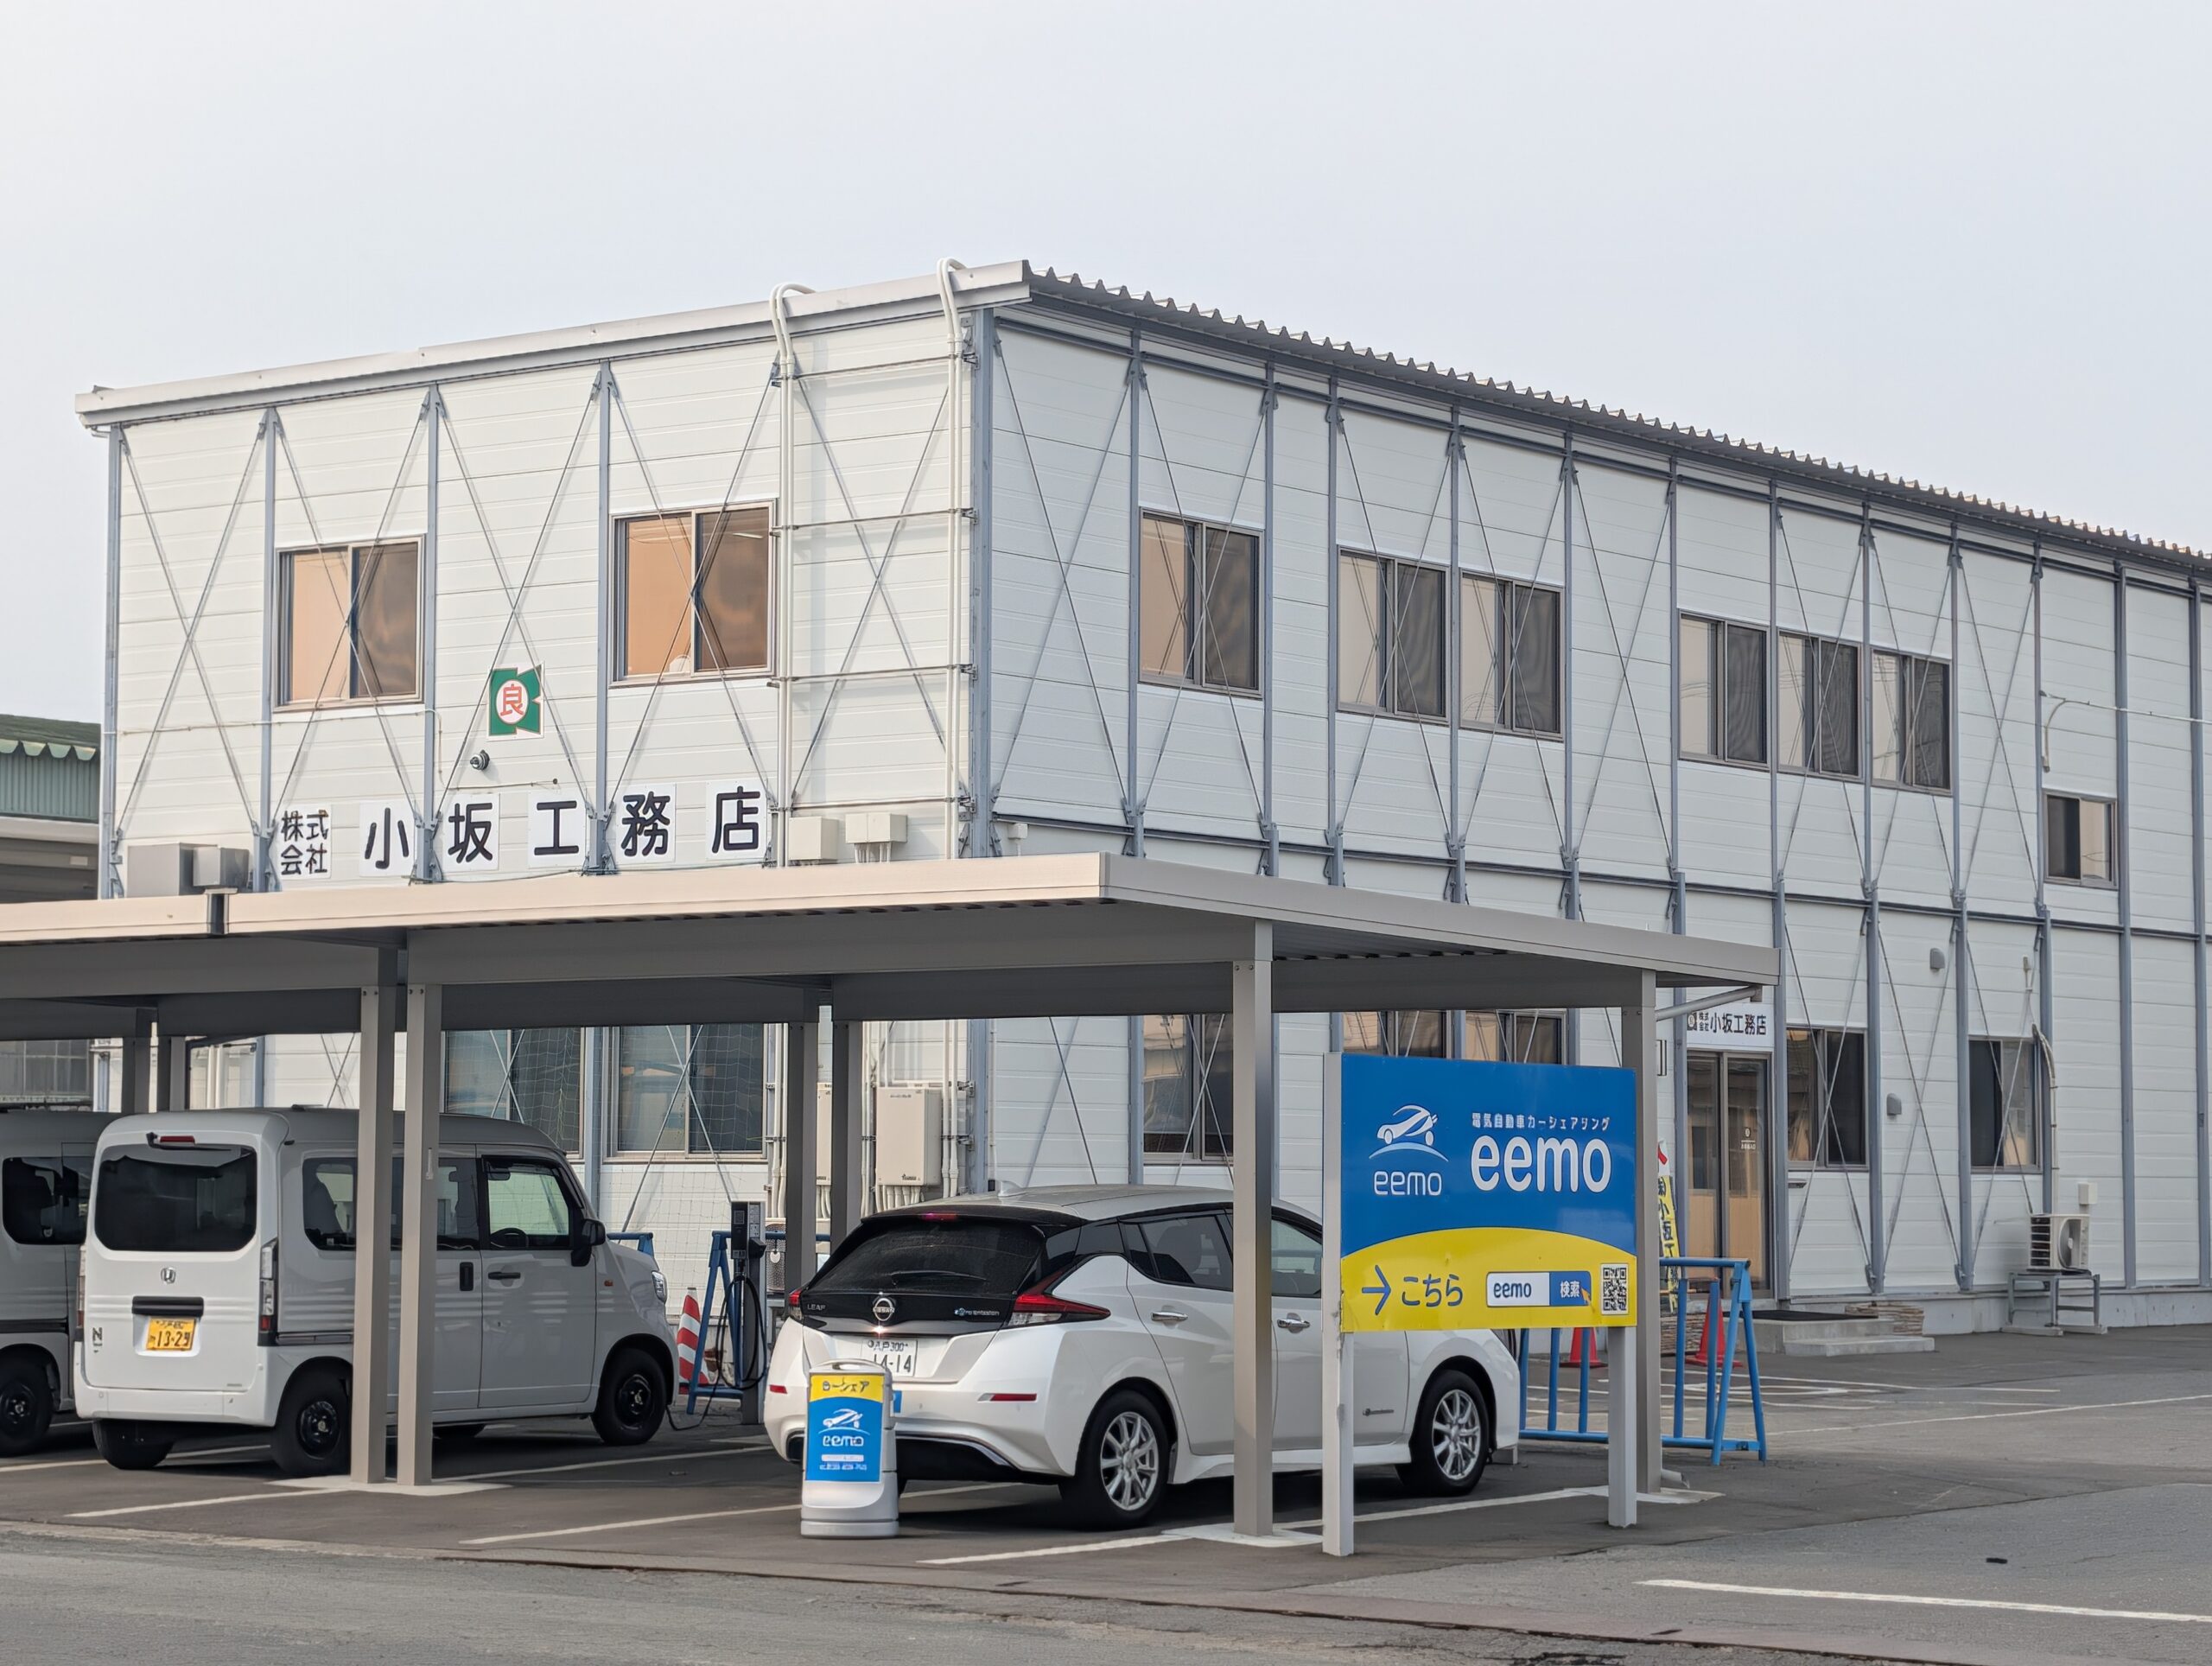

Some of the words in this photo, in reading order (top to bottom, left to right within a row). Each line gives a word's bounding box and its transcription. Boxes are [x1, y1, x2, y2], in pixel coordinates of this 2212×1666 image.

[500, 684, 524, 716] 良
[281, 810, 328, 840] 株式
[365, 785, 760, 870] 小坂工務店
[281, 844, 328, 875] 会社
[1710, 1012, 1767, 1035] 小坂工務店
[1471, 1112, 1611, 1132] 電気自動車カーシェアリング
[1471, 1135, 1612, 1193] eemo
[1373, 1171, 1442, 1196] eemo
[1402, 1274, 1464, 1307] こちら
[1493, 1281, 1532, 1299] eemo
[1560, 1280, 1581, 1298] 検索
